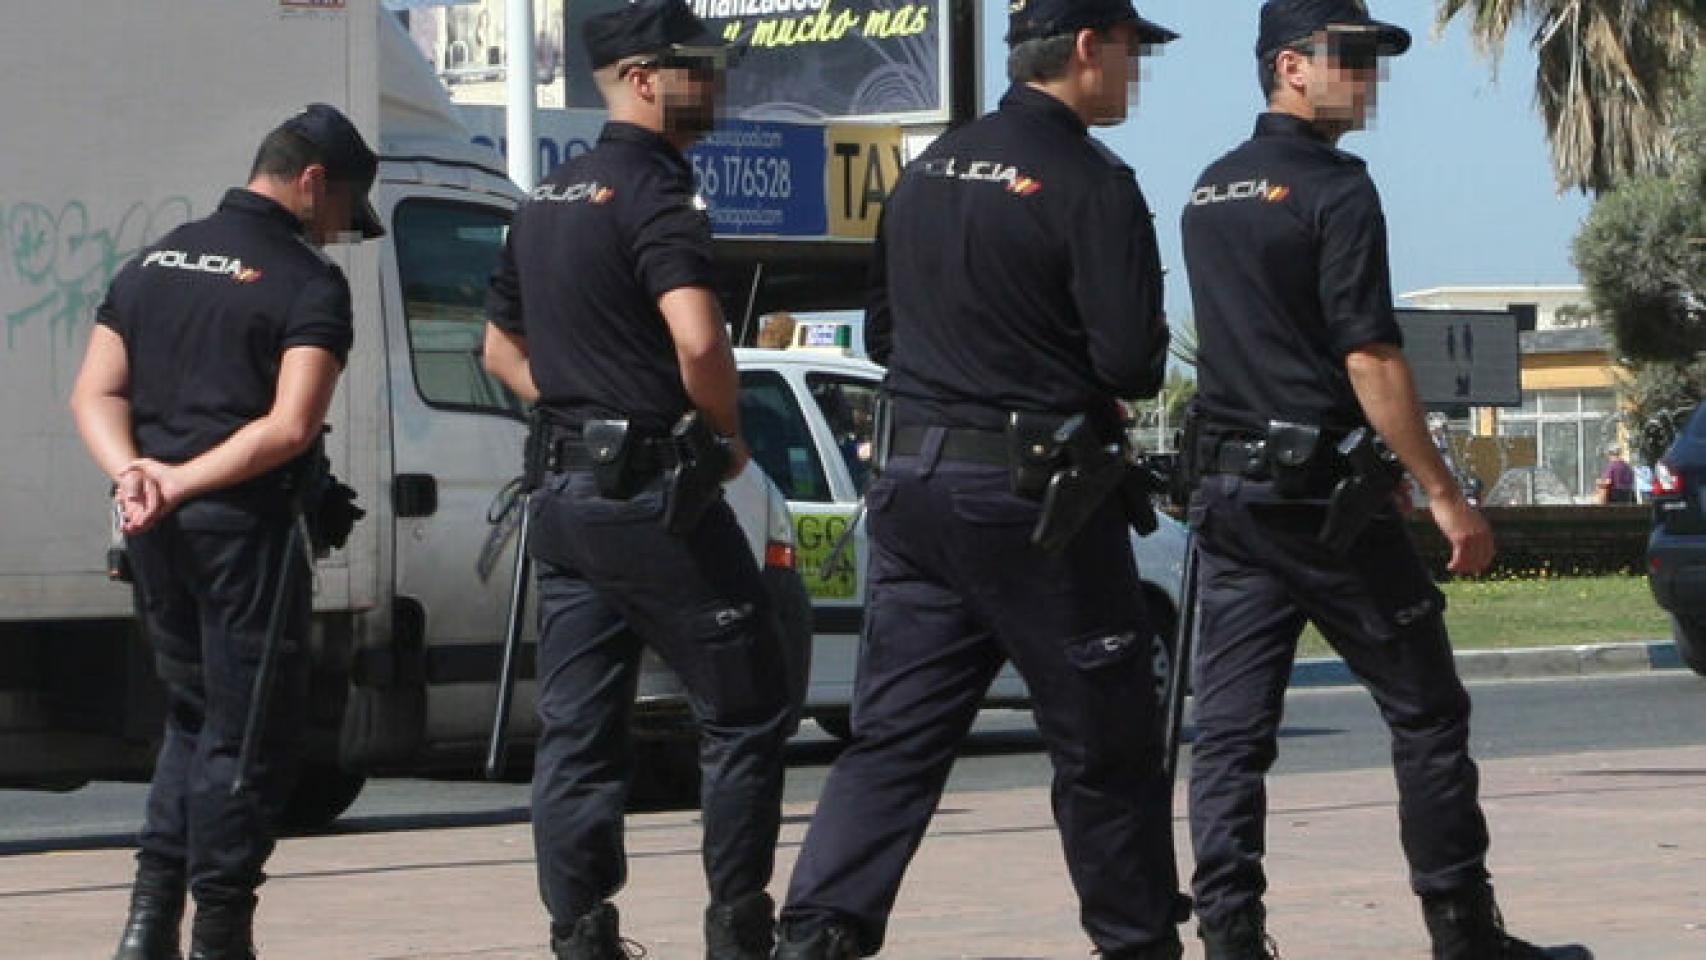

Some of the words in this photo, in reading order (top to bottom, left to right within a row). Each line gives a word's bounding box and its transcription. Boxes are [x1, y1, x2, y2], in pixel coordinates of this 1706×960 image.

[752, 0, 859, 47] mucho
[723, 156, 791, 198] 176528
[833, 142, 901, 219] TA
